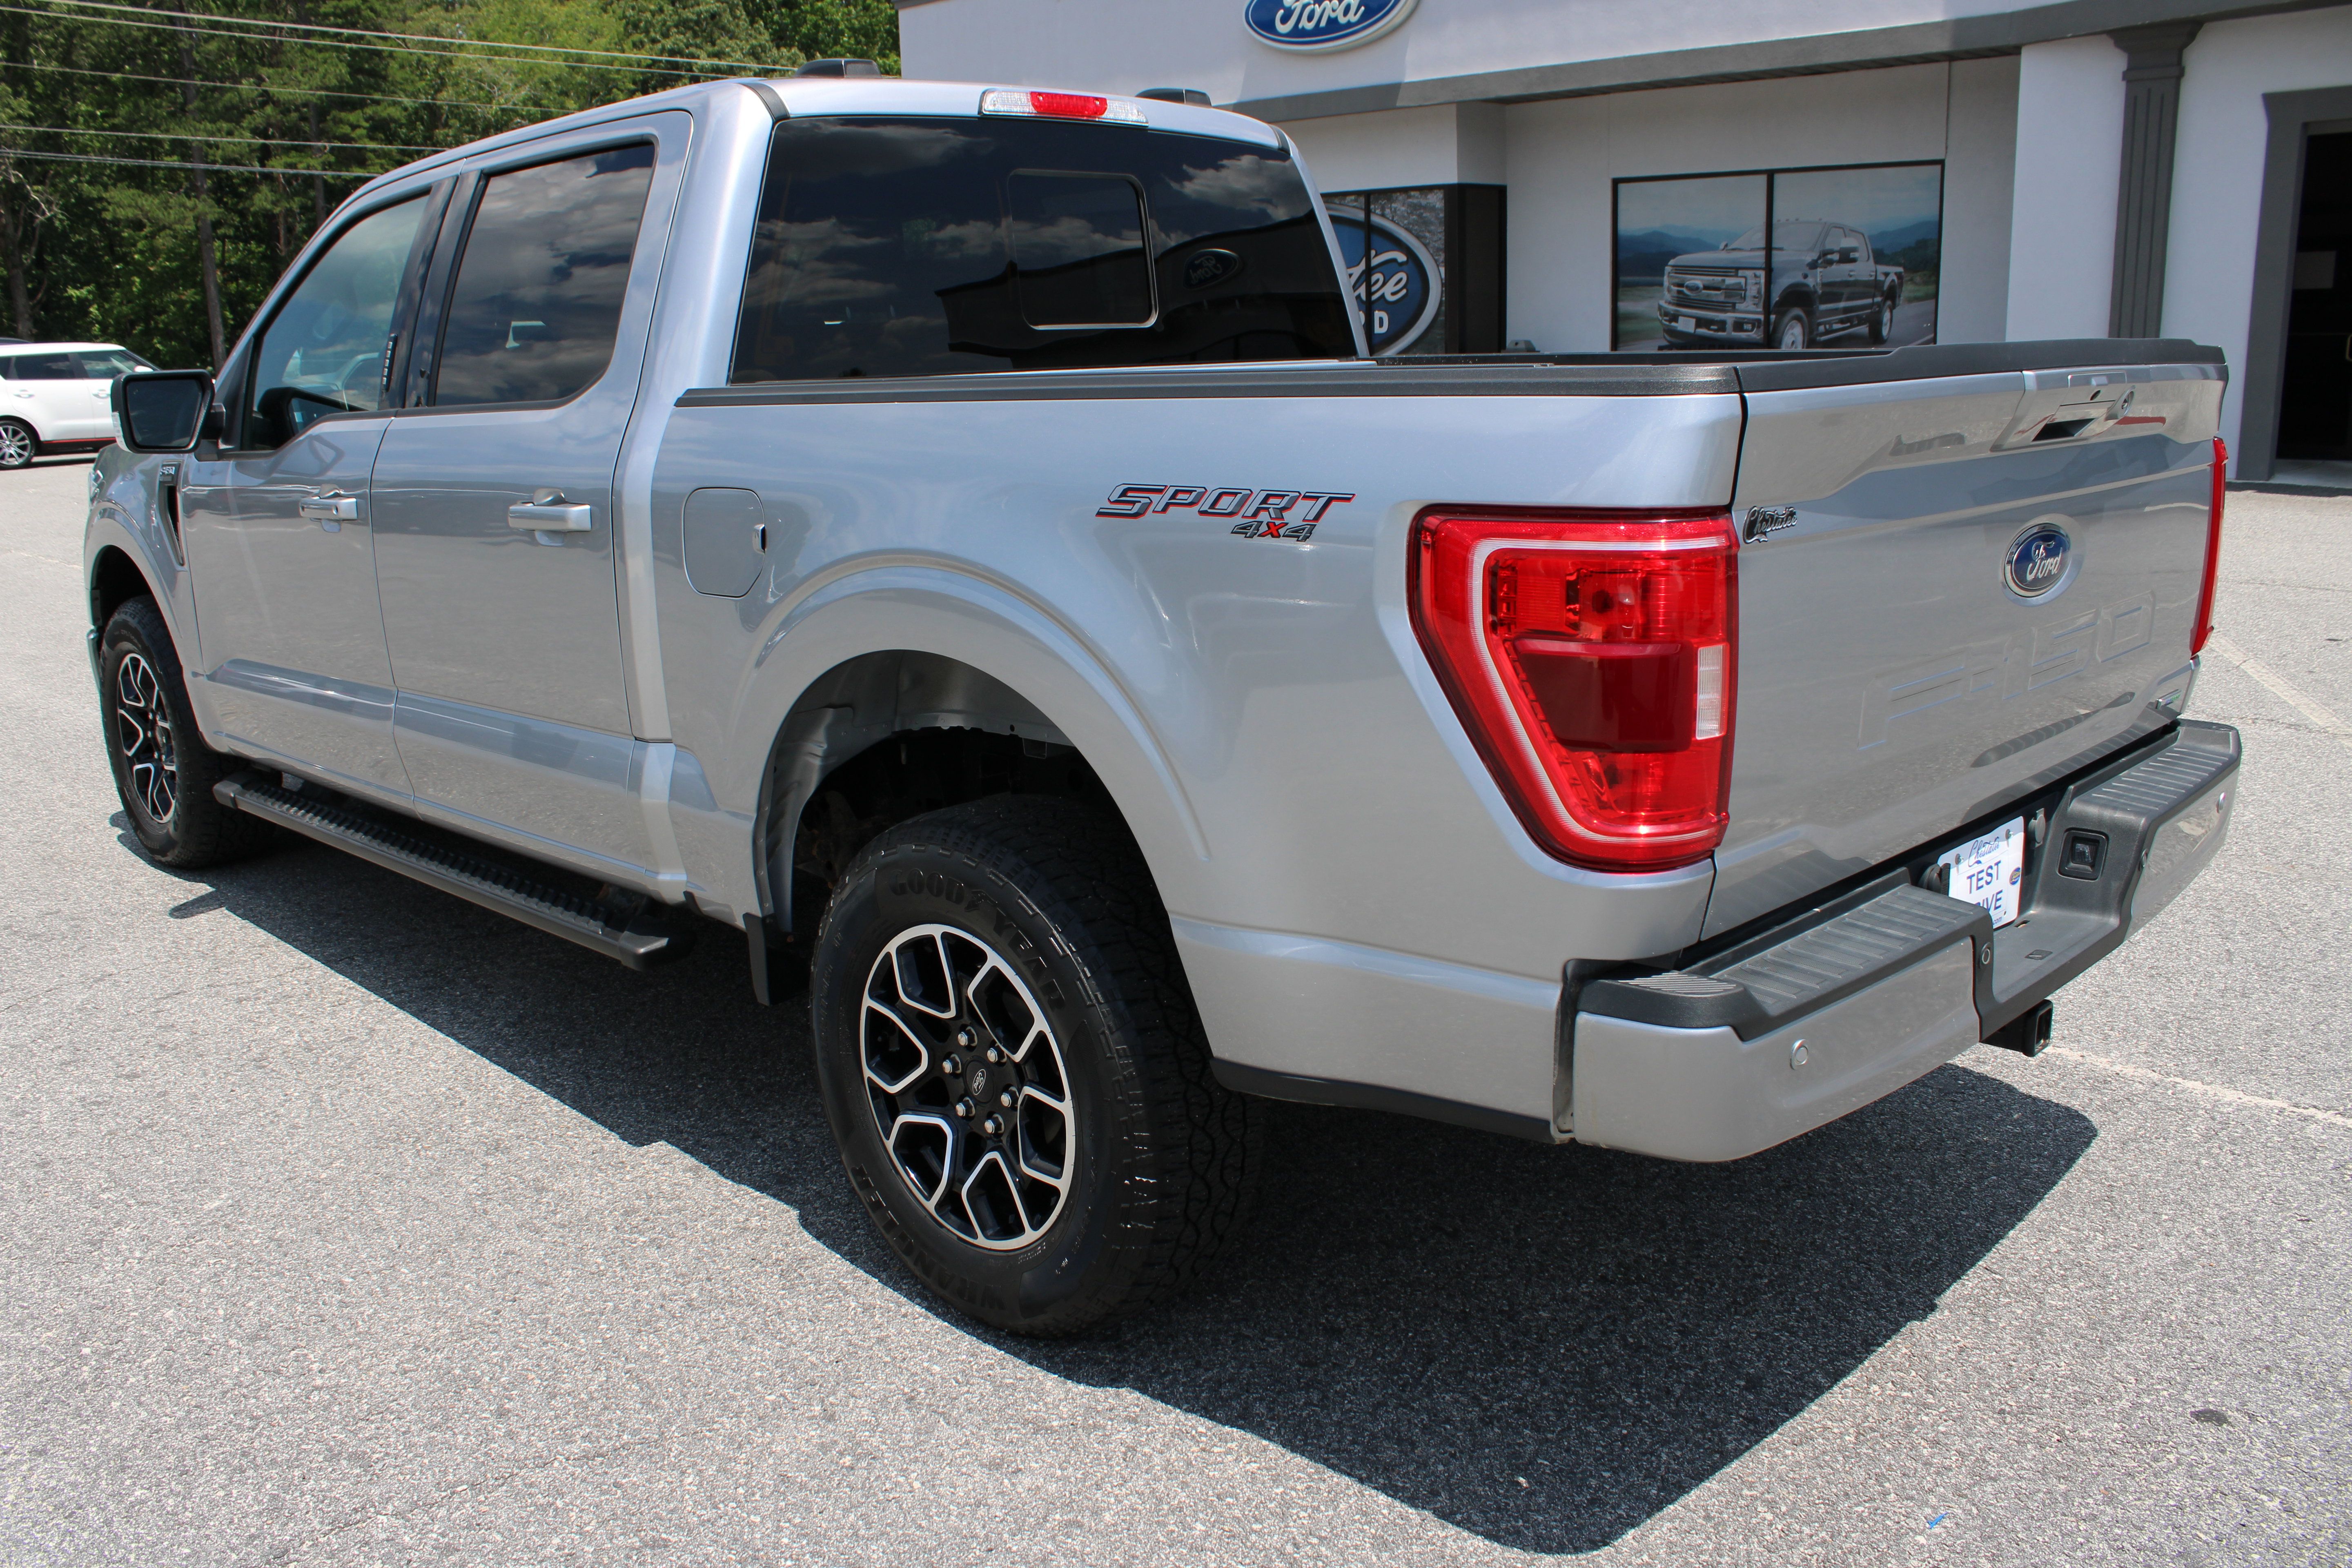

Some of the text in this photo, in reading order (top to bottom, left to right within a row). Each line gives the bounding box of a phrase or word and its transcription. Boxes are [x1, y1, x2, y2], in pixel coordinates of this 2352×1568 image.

[1275, 0, 1365, 33] Ford
[1095, 483, 1357, 523] SPORT
[1743, 506, 1797, 544] Chestatee
[2026, 541, 2063, 581] Ford
[1857, 590, 2156, 751] F-150
[1968, 836, 1999, 867] Chestatee
[1967, 860, 2001, 894] TEST
[974, 1072, 984, 1091] Ford
